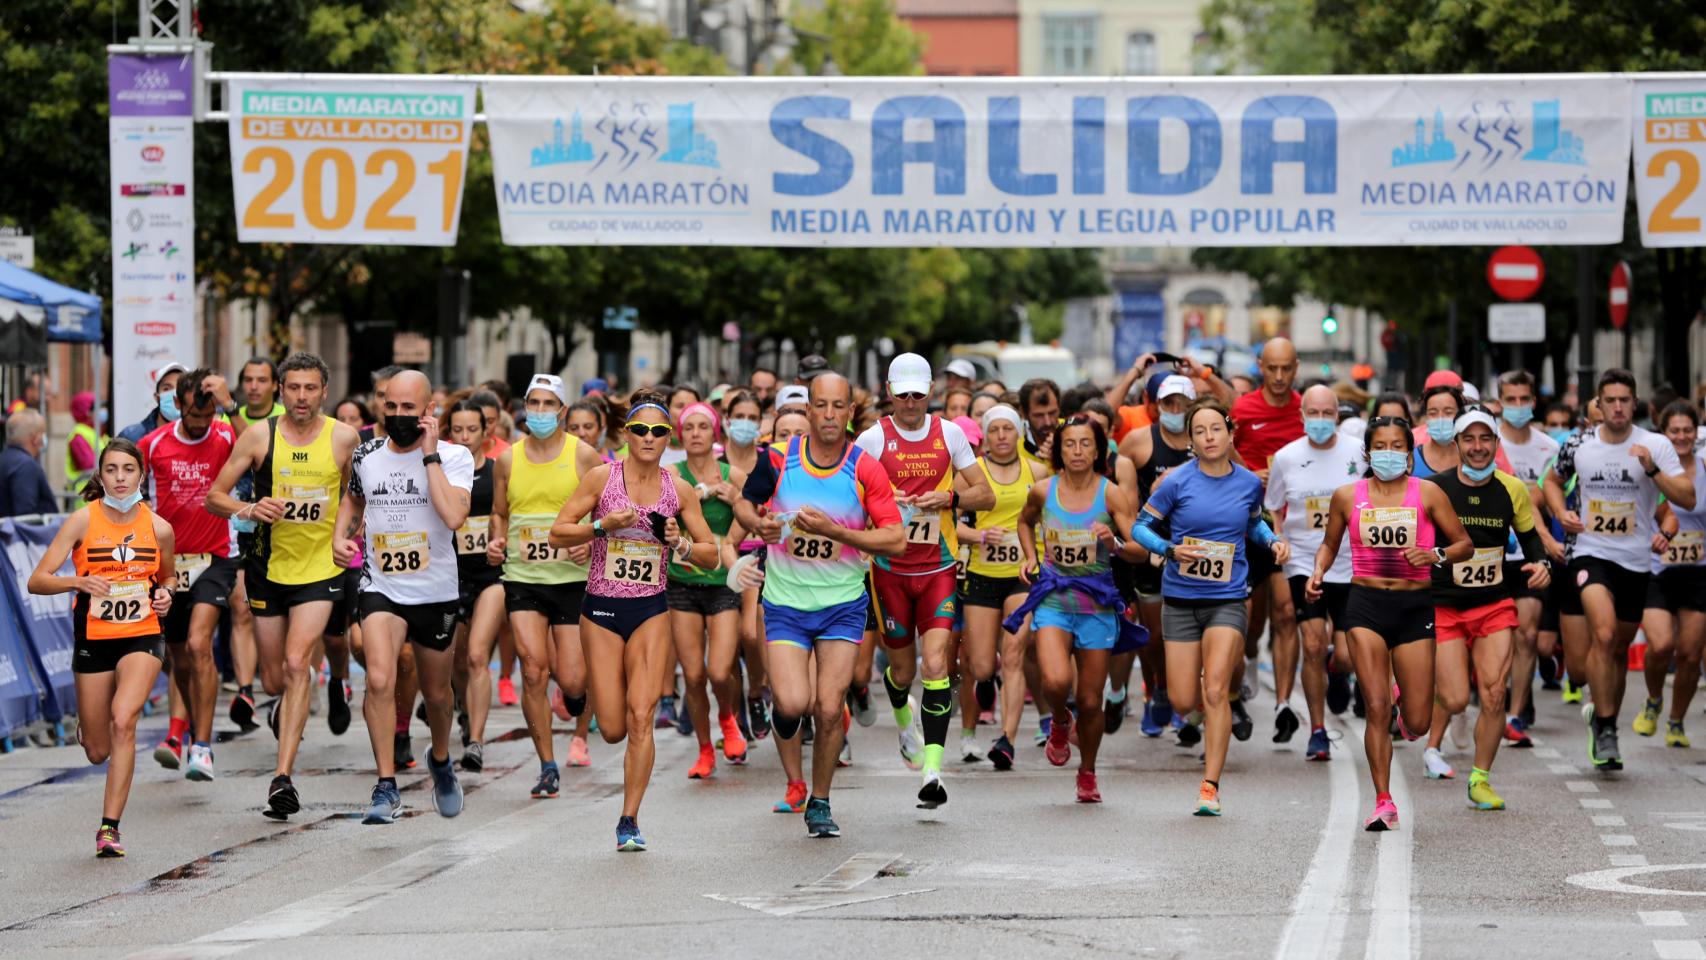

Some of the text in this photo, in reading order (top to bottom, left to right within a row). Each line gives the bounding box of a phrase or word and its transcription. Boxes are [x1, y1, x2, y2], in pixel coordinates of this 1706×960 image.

[248, 93, 458, 116] MEDIA MARATÓN
[248, 120, 458, 140] DE VALLADOLID
[1652, 121, 1691, 139] DE
[769, 95, 1338, 196] SALIDA
[242, 146, 462, 233] 2021
[503, 177, 749, 205] MEDIA MARATÓN
[1361, 175, 1616, 205] MEDIA MARATÓN
[549, 219, 703, 231] CIUDAD DE VALLADOLID
[770, 203, 1336, 234] MEDIA MARATÓN Y LEGUA POPULAR
[1409, 219, 1567, 232] CIUDAD DE VALLADOLID
[897, 469, 937, 478] DE TORO
[905, 462, 929, 470] VINO
[284, 501, 321, 521] 246
[390, 497, 428, 506] MARATÓN
[387, 514, 407, 522] 2021
[1594, 516, 1628, 533] 244
[1368, 525, 1408, 546] 306
[793, 537, 834, 559] 283
[986, 546, 1019, 562] 258
[1053, 545, 1088, 564] 354
[1669, 545, 1698, 561] 373
[381, 550, 421, 572] 238
[613, 557, 653, 583] 352
[1187, 558, 1224, 579] 203
[1461, 565, 1496, 585] 245
[100, 600, 141, 621] 202
